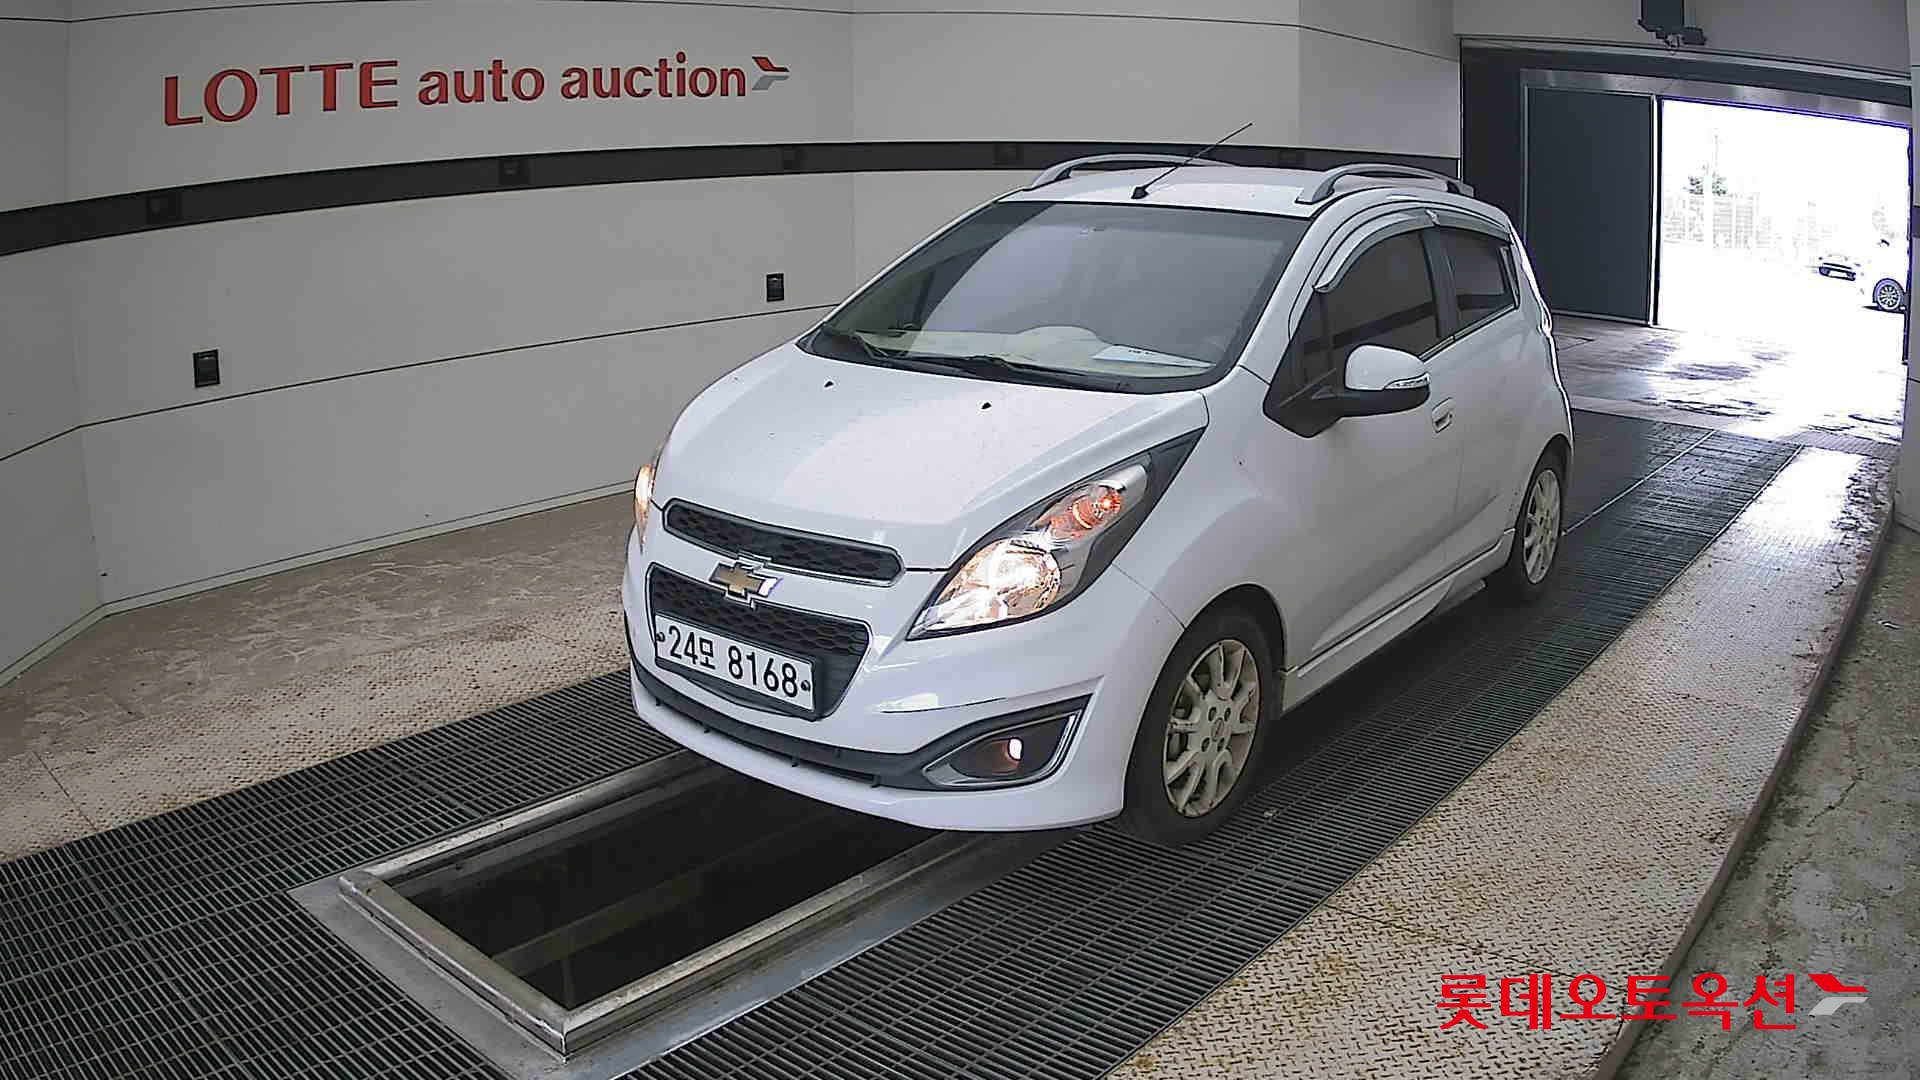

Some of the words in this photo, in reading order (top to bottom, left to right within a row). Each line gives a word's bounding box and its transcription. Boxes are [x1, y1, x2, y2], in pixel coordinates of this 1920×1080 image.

[164, 60, 399, 126] LOTTE
[417, 58, 545, 105] auto
[560, 51, 747, 101] auction
[668, 625, 716, 670] 24모
[728, 645, 798, 698] 8168
